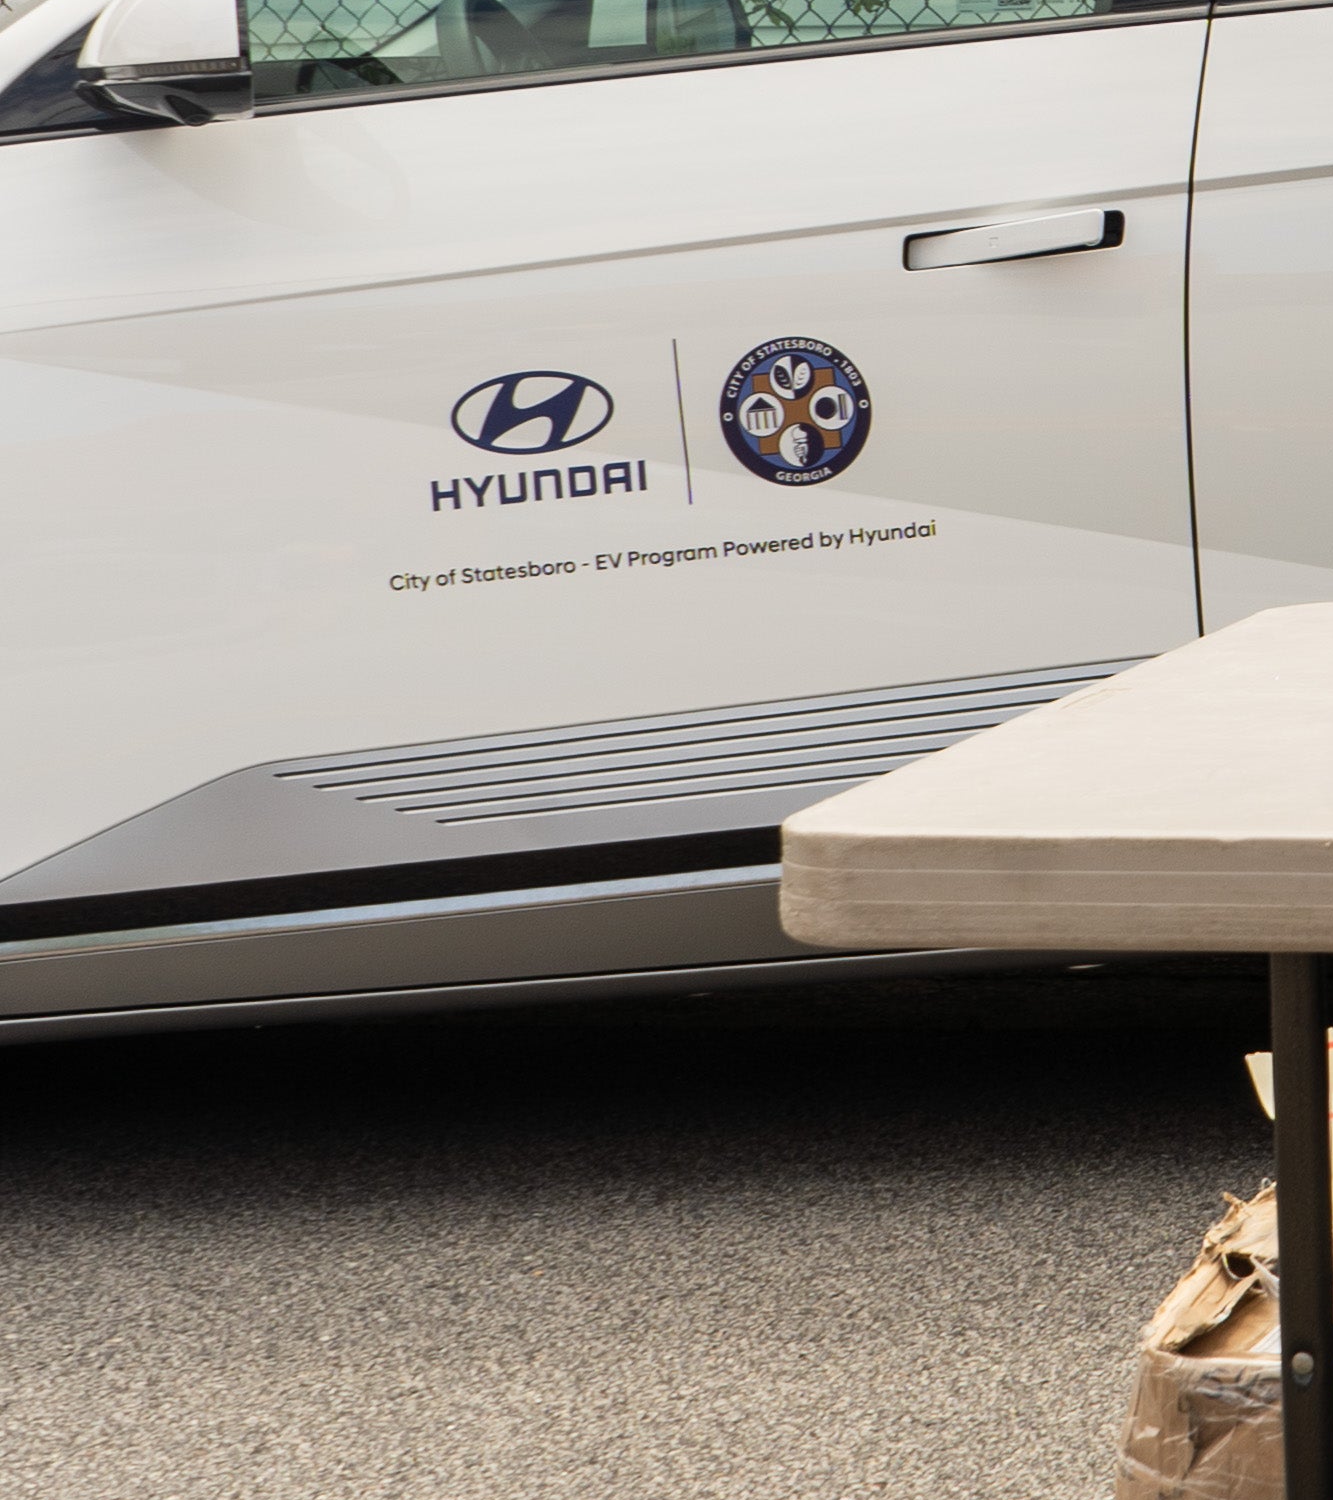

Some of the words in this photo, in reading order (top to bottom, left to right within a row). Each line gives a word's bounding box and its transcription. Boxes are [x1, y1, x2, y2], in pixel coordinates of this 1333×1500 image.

[726, 370, 745, 398] CITY
[741, 356, 757, 371] OF
[756, 339, 832, 360] STATESBORO
[839, 359, 863, 387] 1803
[430, 460, 647, 511] HYUNDAI
[775, 466, 833, 483] GEORGIA
[389, 572, 431, 592] City
[436, 568, 457, 586] of
[460, 560, 576, 584] Statesboro
[595, 552, 622, 571] EV
[628, 545, 718, 567] Program
[723, 533, 813, 557] Powered
[819, 531, 844, 549] by
[850, 519, 937, 546] Hyundai
